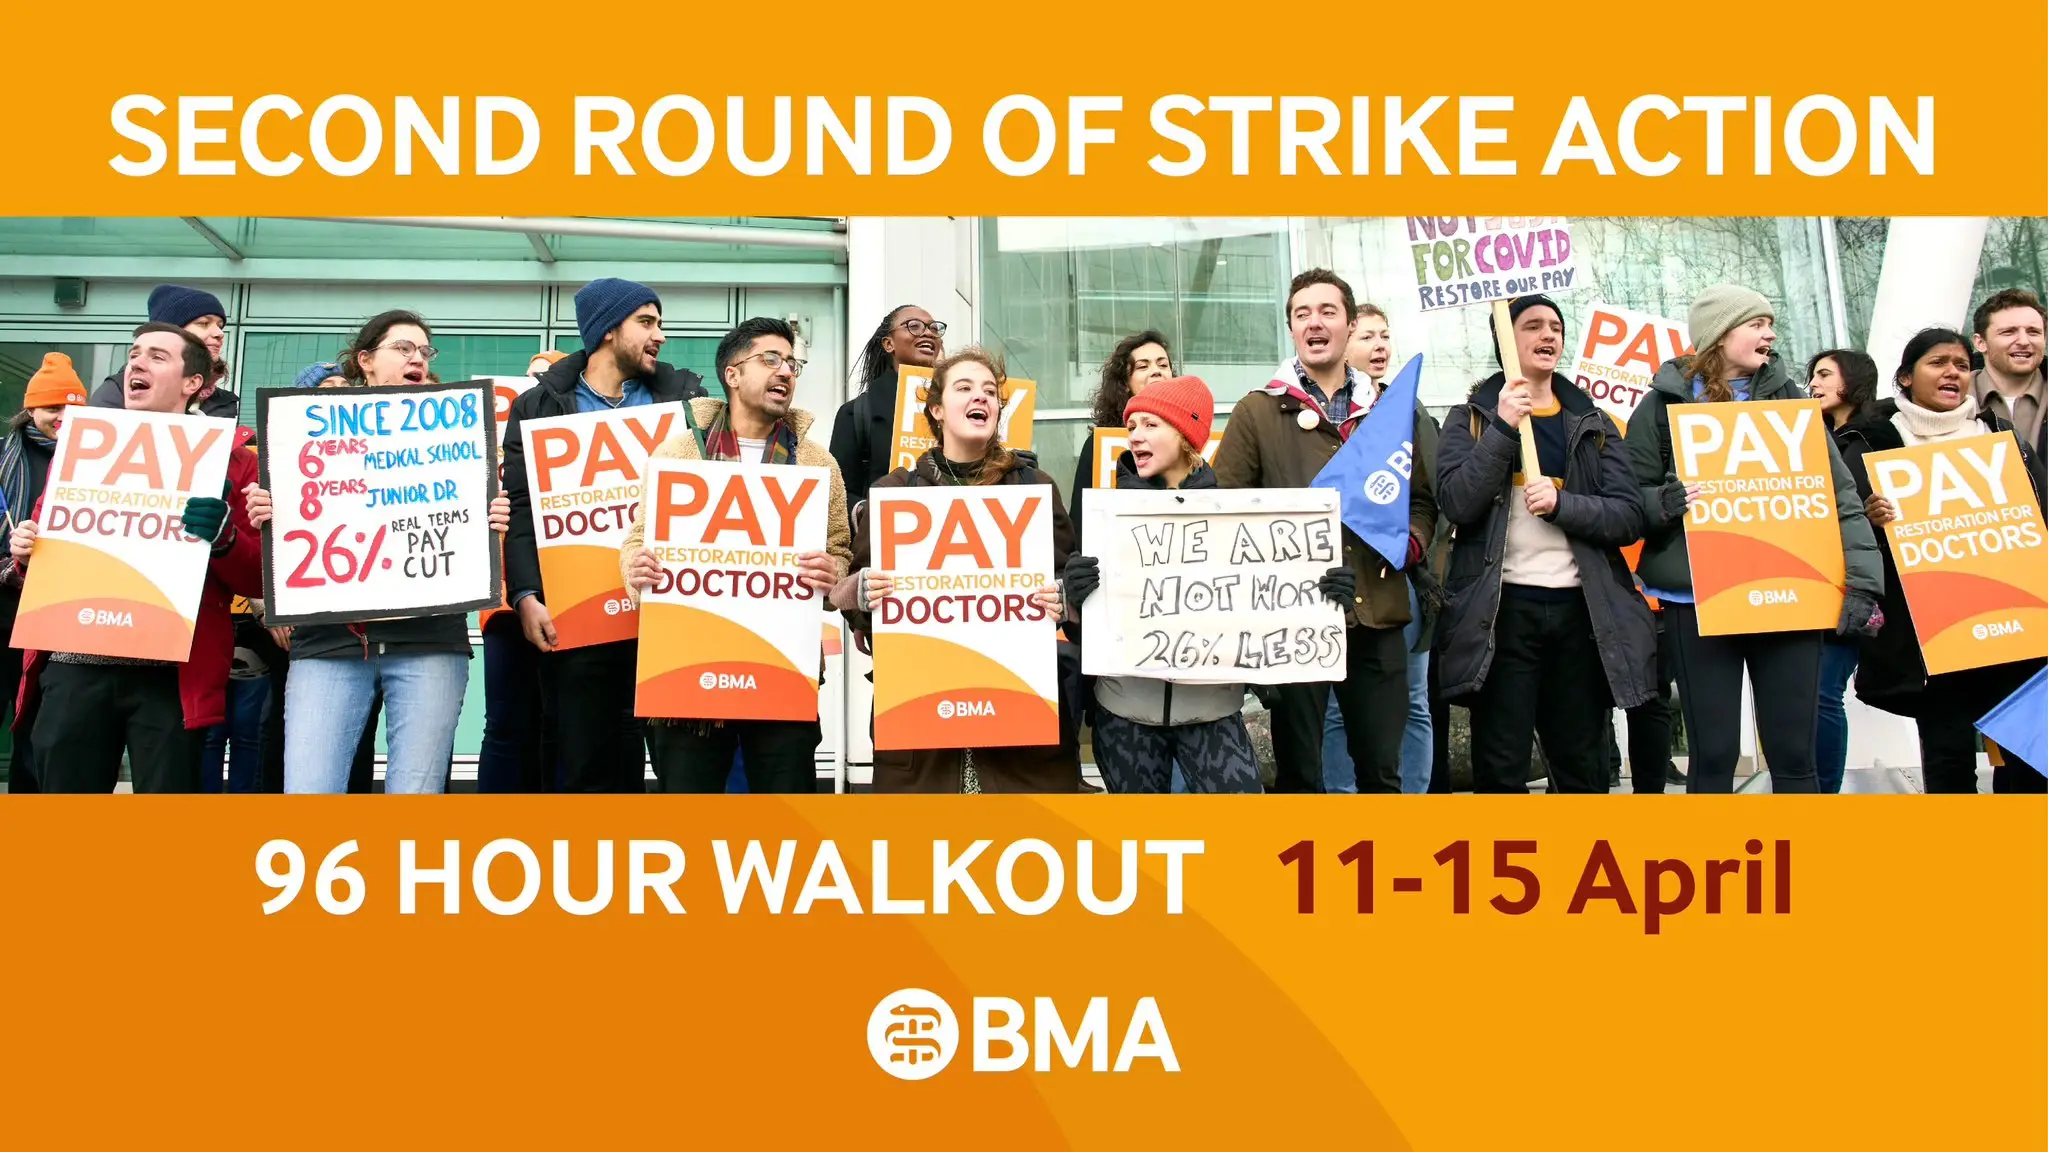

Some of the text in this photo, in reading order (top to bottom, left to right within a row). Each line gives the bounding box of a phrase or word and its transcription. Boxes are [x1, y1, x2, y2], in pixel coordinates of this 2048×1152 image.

[1411, 229, 1571, 285] FOR COVID
[1418, 267, 1574, 309] RESTORE OUR PAY
[1579, 361, 1653, 387] RESTORATI
[1575, 375, 1643, 408] DOCT
[305, 400, 392, 437] SINCE
[400, 392, 479, 431] 2008
[59, 417, 224, 492] PAY
[298, 440, 325, 479] 6
[316, 438, 369, 455] YEARS
[364, 450, 424, 470] MEDICAL
[428, 441, 482, 464] SCHOOL
[531, 412, 675, 493] PAY
[1677, 408, 1813, 478] PAY
[55, 486, 172, 510] RESTORATION
[541, 484, 643, 511] RESTORATIO
[1697, 475, 1825, 495] ESTORATION FOR
[1874, 441, 2008, 521] PAY
[300, 478, 459, 521] 8 YEARS JUNIOR DR
[655, 471, 820, 547] PAY
[1691, 493, 1829, 525] DOCTORS
[47, 505, 201, 543] DOCTOR
[391, 508, 469, 533] REAL TERMS
[543, 502, 639, 540] DOCT
[880, 497, 1042, 571] PAY
[1894, 504, 2033, 539] RESTORATION FOR
[283, 523, 393, 588] 26%
[408, 526, 449, 554] PAY
[654, 547, 777, 566] RESTORATION
[1132, 518, 1334, 567] WE ARE
[1898, 522, 2043, 568] DOCTORS
[404, 551, 455, 578] CUT
[782, 552, 801, 567] FO
[652, 568, 814, 601] DOCTORS
[890, 573, 1045, 591] ESTORATION FOR
[1140, 574, 1340, 618] NOT WOR
[1765, 590, 1798, 605] BMA
[96, 609, 133, 627] BMA
[882, 593, 1046, 625] DOCTORS
[1988, 619, 2024, 638] BMA
[1135, 625, 1342, 669] 26% LESS
[718, 673, 757, 690] BMA
[957, 700, 996, 717] BMA
